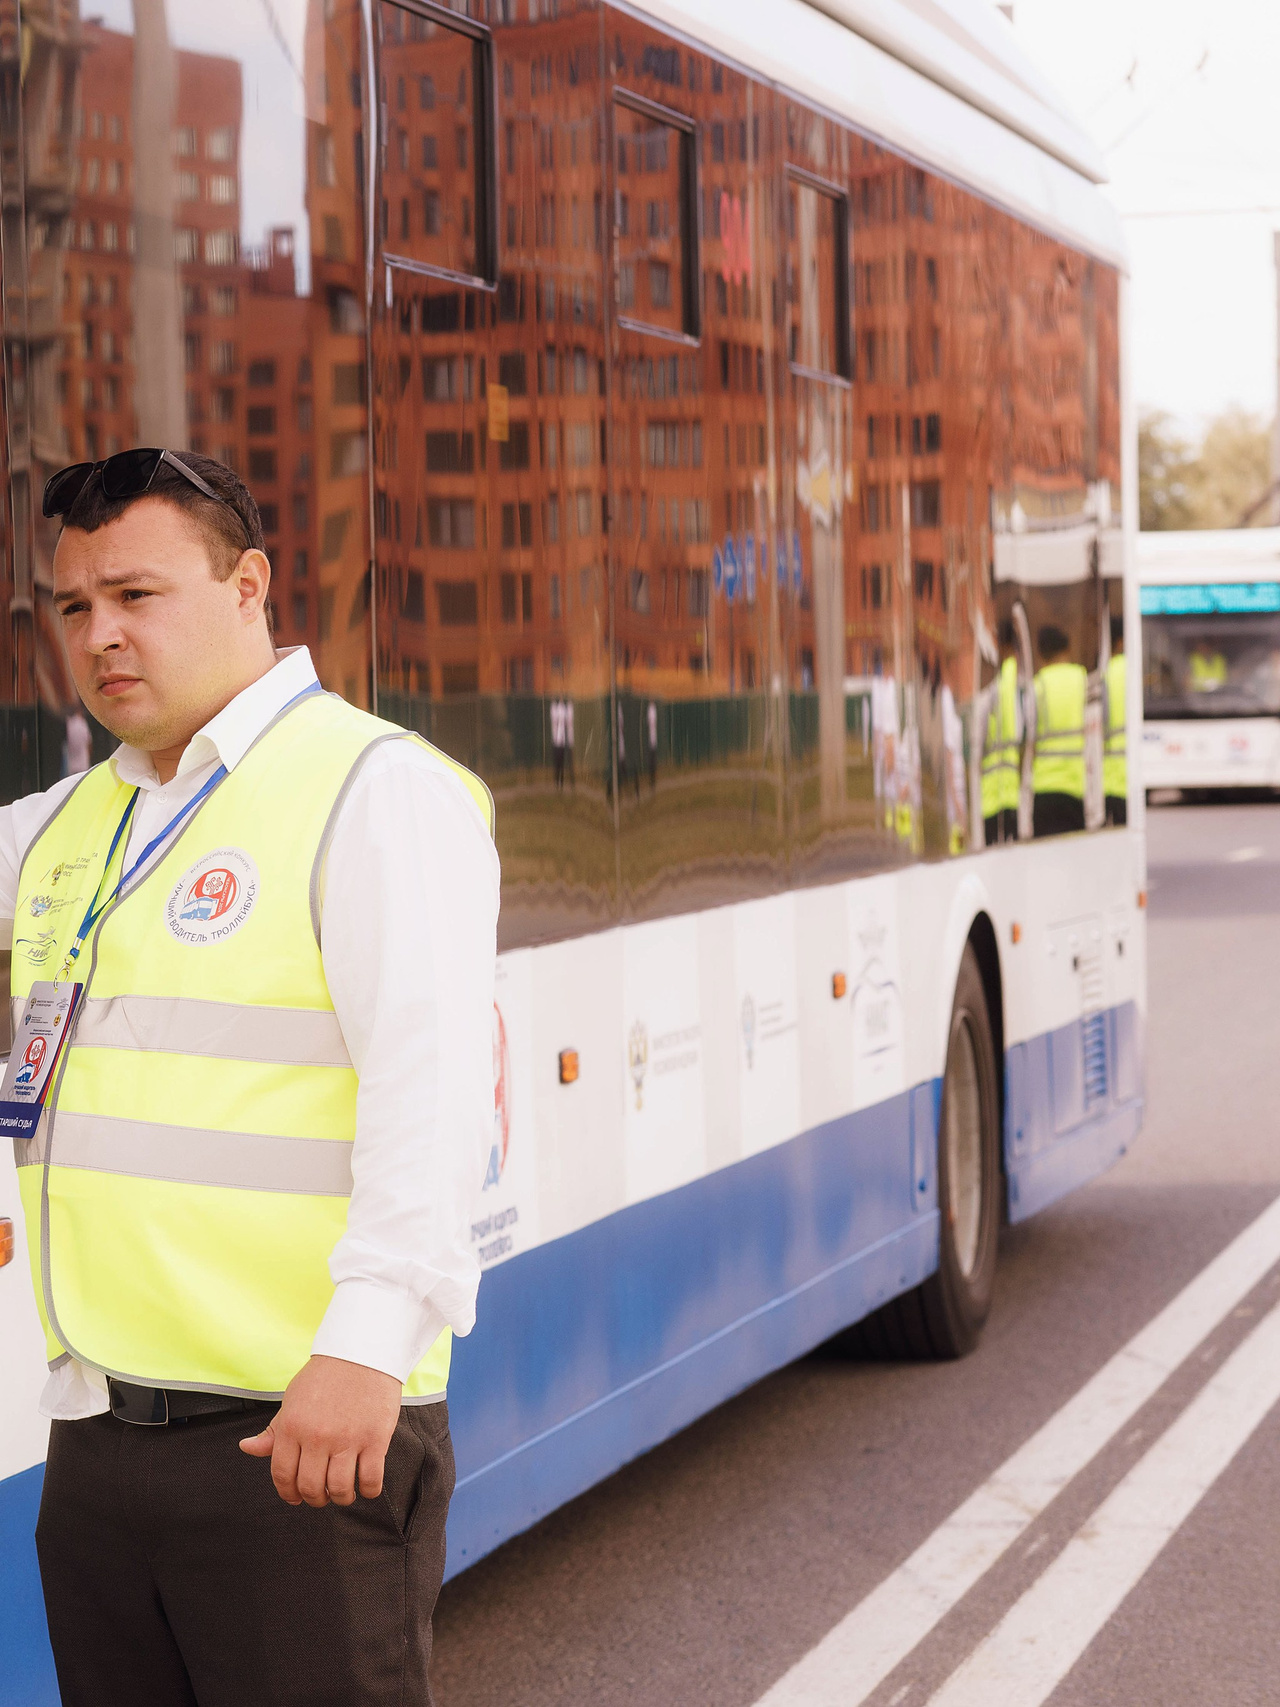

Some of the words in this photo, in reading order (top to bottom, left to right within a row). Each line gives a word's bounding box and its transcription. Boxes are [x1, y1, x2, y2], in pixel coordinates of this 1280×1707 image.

[234, 852, 252, 873] КОНКУРС
[169, 919, 208, 942] ВОДИТЕЛЬ
[18, 1118, 33, 1129] СУДЬЯ
